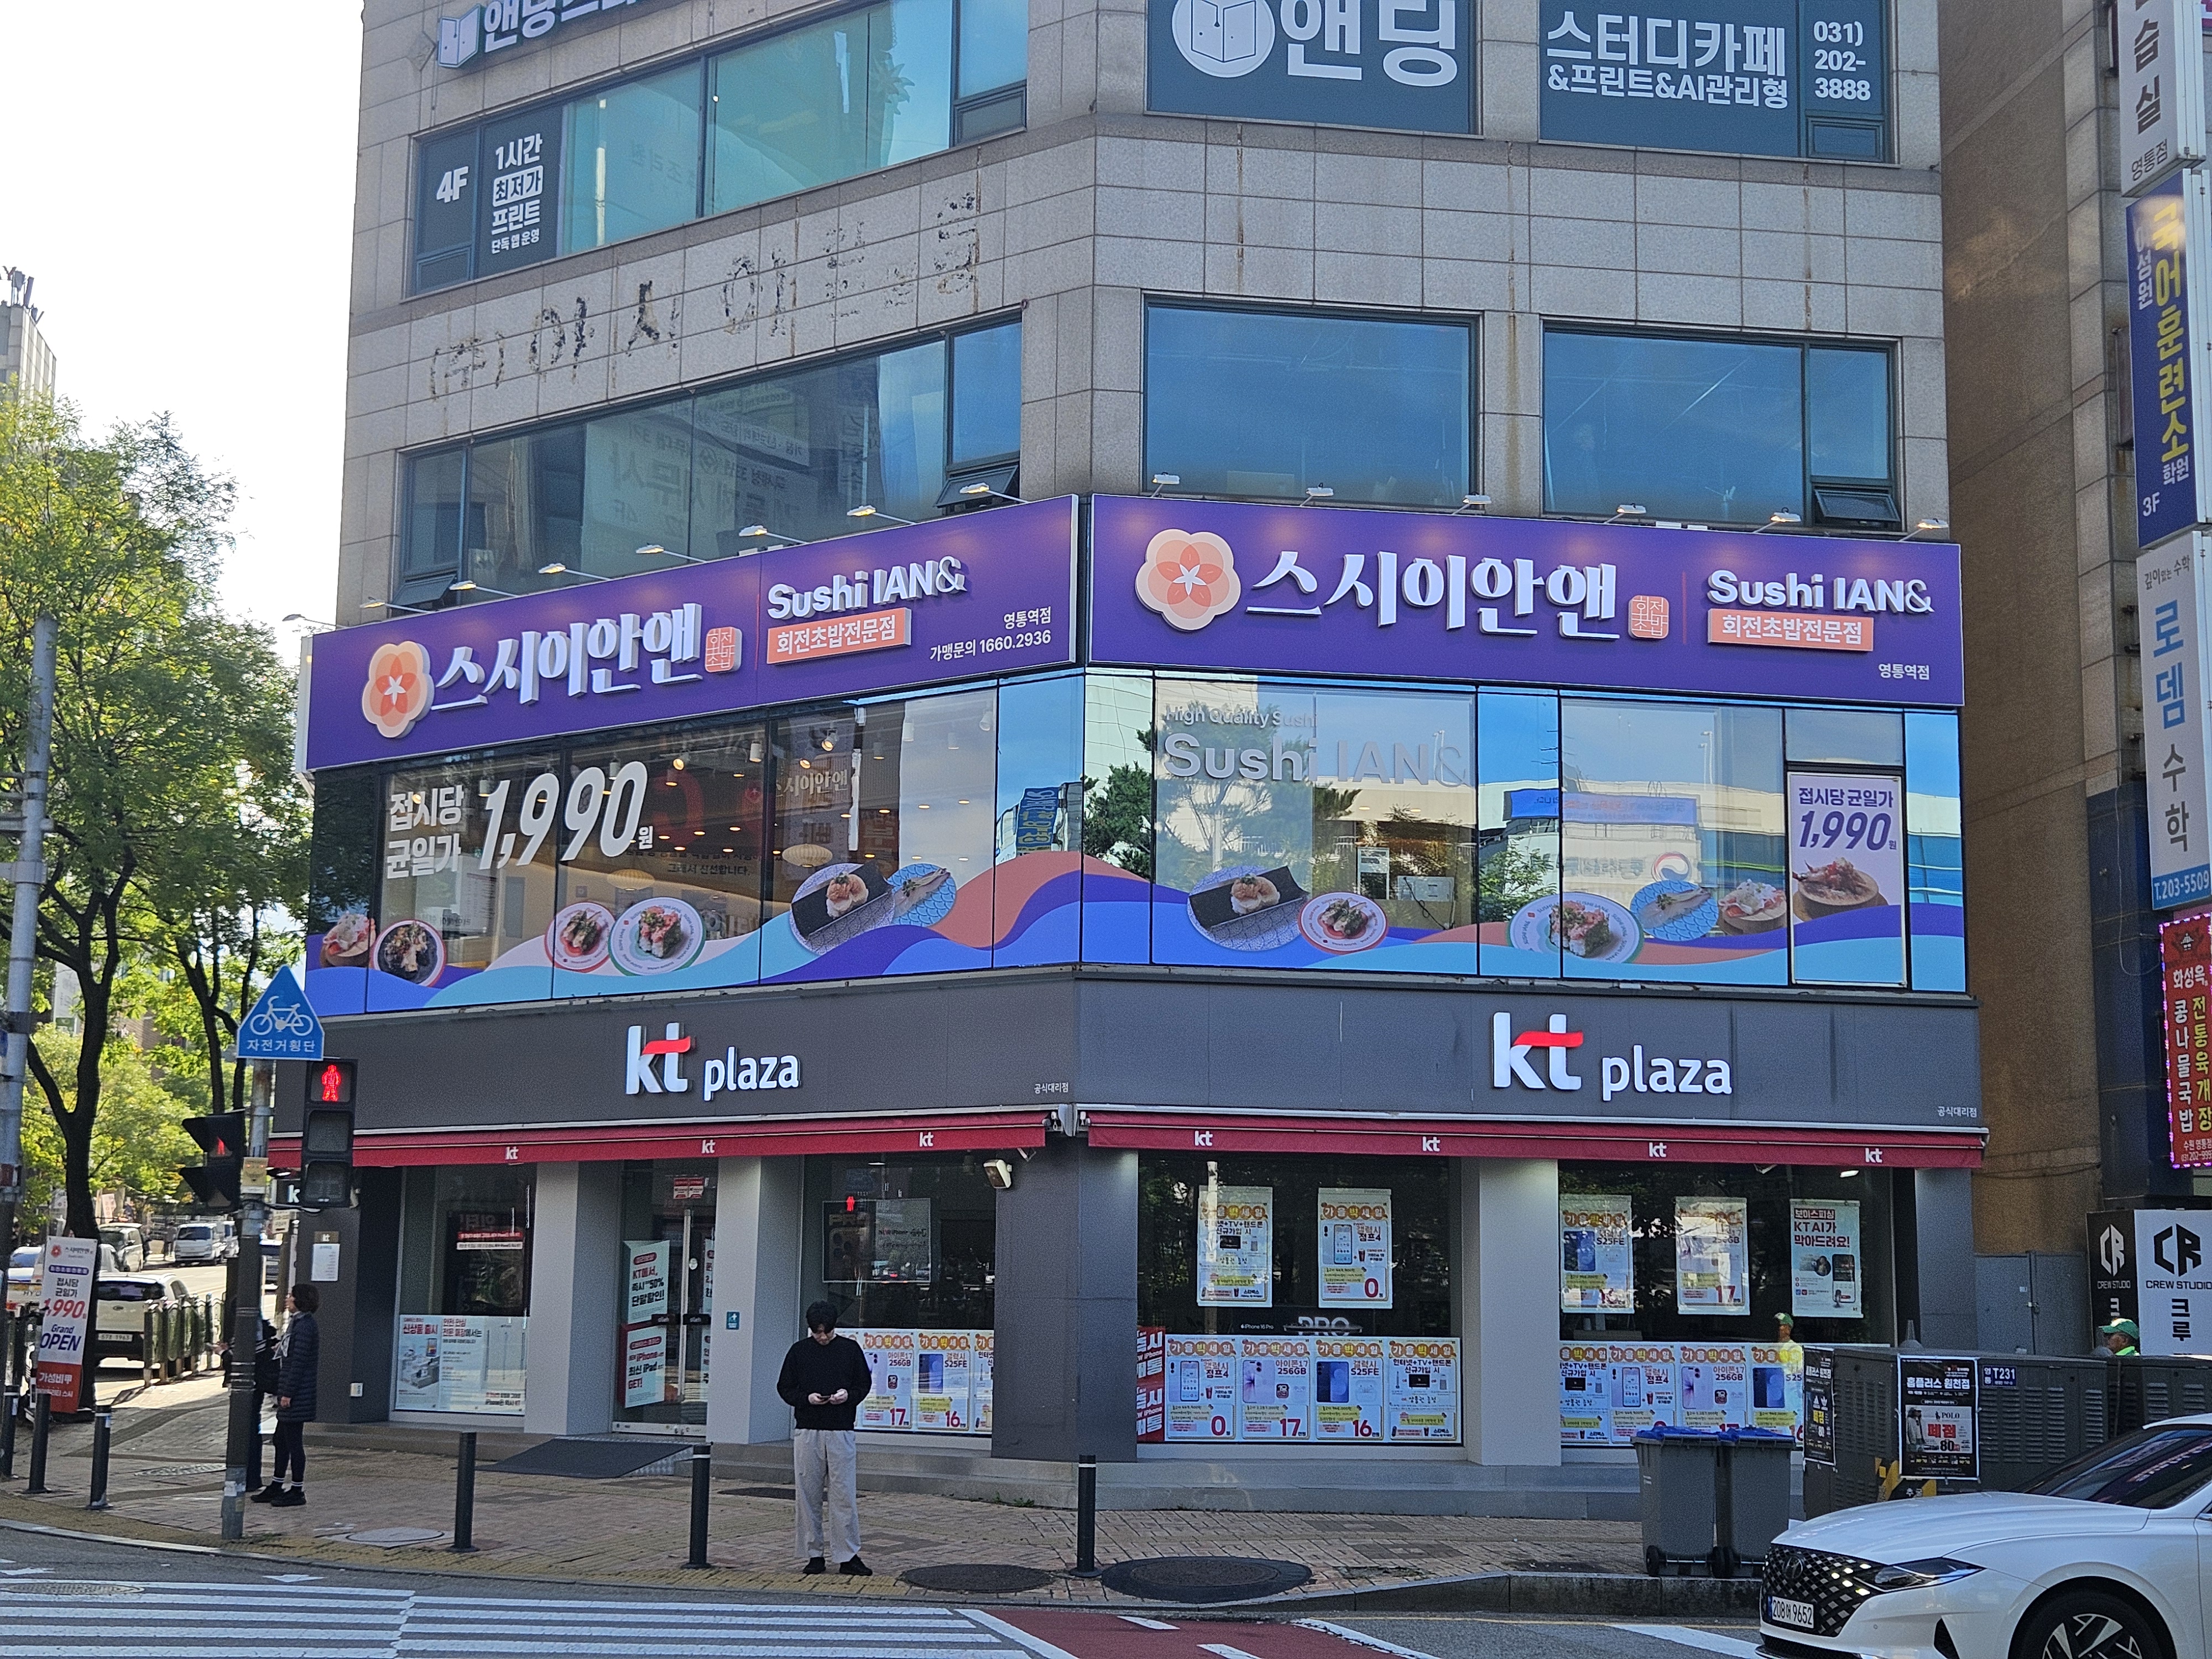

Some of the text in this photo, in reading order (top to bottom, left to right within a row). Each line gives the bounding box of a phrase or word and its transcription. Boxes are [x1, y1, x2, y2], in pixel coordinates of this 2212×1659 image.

[1547, 11, 1786, 76] 스터디카페
[1813, 21, 1864, 45] 031)
[1814, 50, 1866, 72] 202-
[2134, 0, 2161, 134] 습실
[1547, 64, 1788, 109] &프린트&AI관리형
[1814, 77, 1871, 101] 3888
[495, 133, 543, 170] 1시간
[2131, 138, 2168, 181] 영통점
[436, 166, 469, 203] 4F
[495, 168, 542, 204] 최저가
[492, 200, 540, 235] 프린트
[492, 228, 540, 254] 단독 앱 운영
[2163, 455, 2189, 485] 학원
[2142, 492, 2160, 517] 3F
[2173, 554, 2190, 576] 수학
[768, 556, 967, 619] Sushi IAN&
[1246, 551, 1621, 639] 스시이안앤
[1709, 570, 1935, 613] Sushi IAN&
[1004, 607, 1051, 630] 영통역점
[1722, 614, 1862, 644] 회전초밥전문점
[776, 614, 896, 655] 회전초밥전문점
[930, 630, 1051, 662] 가맹문의 1660.2936
[431, 603, 703, 712] 스시이안앤
[2153, 599, 2186, 729] 로뎀
[1879, 664, 1930, 680] 영통역점
[1166, 705, 1317, 728] High Quality Sushi
[1164, 732, 1467, 788] Sushi IAN&
[390, 785, 464, 831] 접시당
[1799, 787, 1893, 807] 접시당 균일가
[2162, 743, 2190, 852] 수학
[479, 761, 653, 870] 1,990 원
[1799, 810, 1897, 851] 1,990 원
[388, 833, 461, 879] 균일가
[2154, 873, 2209, 902] T.203-5509
[2173, 964, 2205, 989] 화성옥
[247, 1040, 315, 1052] 자전거횡단
[1493, 1011, 1732, 1101] kt plaza
[625, 1022, 800, 1102] kt plaza
[2174, 1000, 2194, 1133] 콩나물국밥
[2193, 997, 2212, 1131] 전통육개장
[1034, 1082, 1069, 1094] 공식대리점
[1937, 1106, 1978, 1118] 공식대리점
[701, 1139, 715, 1154] kt
[919, 1131, 933, 1147] kt
[1194, 1130, 1213, 1146] kt
[1422, 1136, 1440, 1152] kt
[505, 1147, 519, 1160] kt
[1648, 1142, 1667, 1159] kt
[1865, 1147, 1883, 1164] kt
[2189, 1150, 2212, 1161] 202-999
[1795, 1209, 1835, 1219] 보이스피싱
[1794, 1235, 1850, 1248] 막아드려요!
[2100, 1224, 2125, 1276] CR
[2153, 1223, 2201, 1277] CR
[55, 1288, 77, 1297] 균일가
[57, 1278, 79, 1287] 접시당
[1365, 1278, 1379, 1297] 0
[2146, 1280, 2212, 1290] CREW STUDIO
[51, 1324, 74, 1333] Grand
[40, 1333, 81, 1351] OPEN
[1992, 1368, 2015, 1380] T231
[890, 1408, 906, 1426] 17
[946, 1411, 960, 1427] 16
[1211, 1416, 1226, 1436] 0
[1280, 1418, 1301, 1437] 17
[1353, 1420, 1372, 1437] 16
[1940, 1440, 1954, 1452] 80
[1793, 1604, 1813, 1626] 9652
